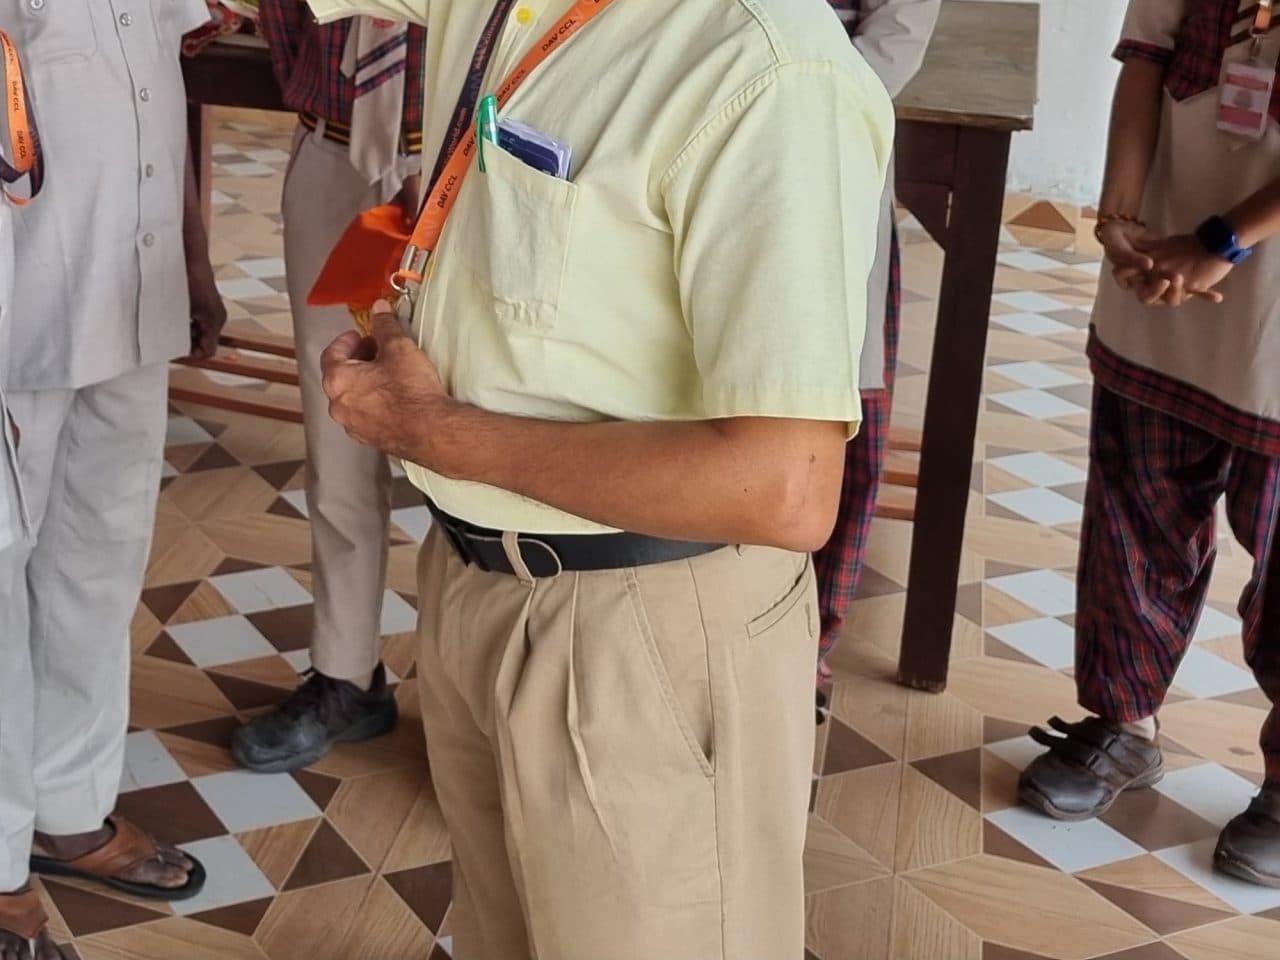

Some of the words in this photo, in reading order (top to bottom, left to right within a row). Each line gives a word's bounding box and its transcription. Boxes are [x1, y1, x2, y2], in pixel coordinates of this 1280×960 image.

[541, 33, 559, 52] DAV
[558, 18, 577, 36] CCL
[497, 82, 512, 103] DAV
[511, 68, 527, 85] CCL
[437, 188, 451, 208] DAV
[446, 174, 458, 192] CCL
